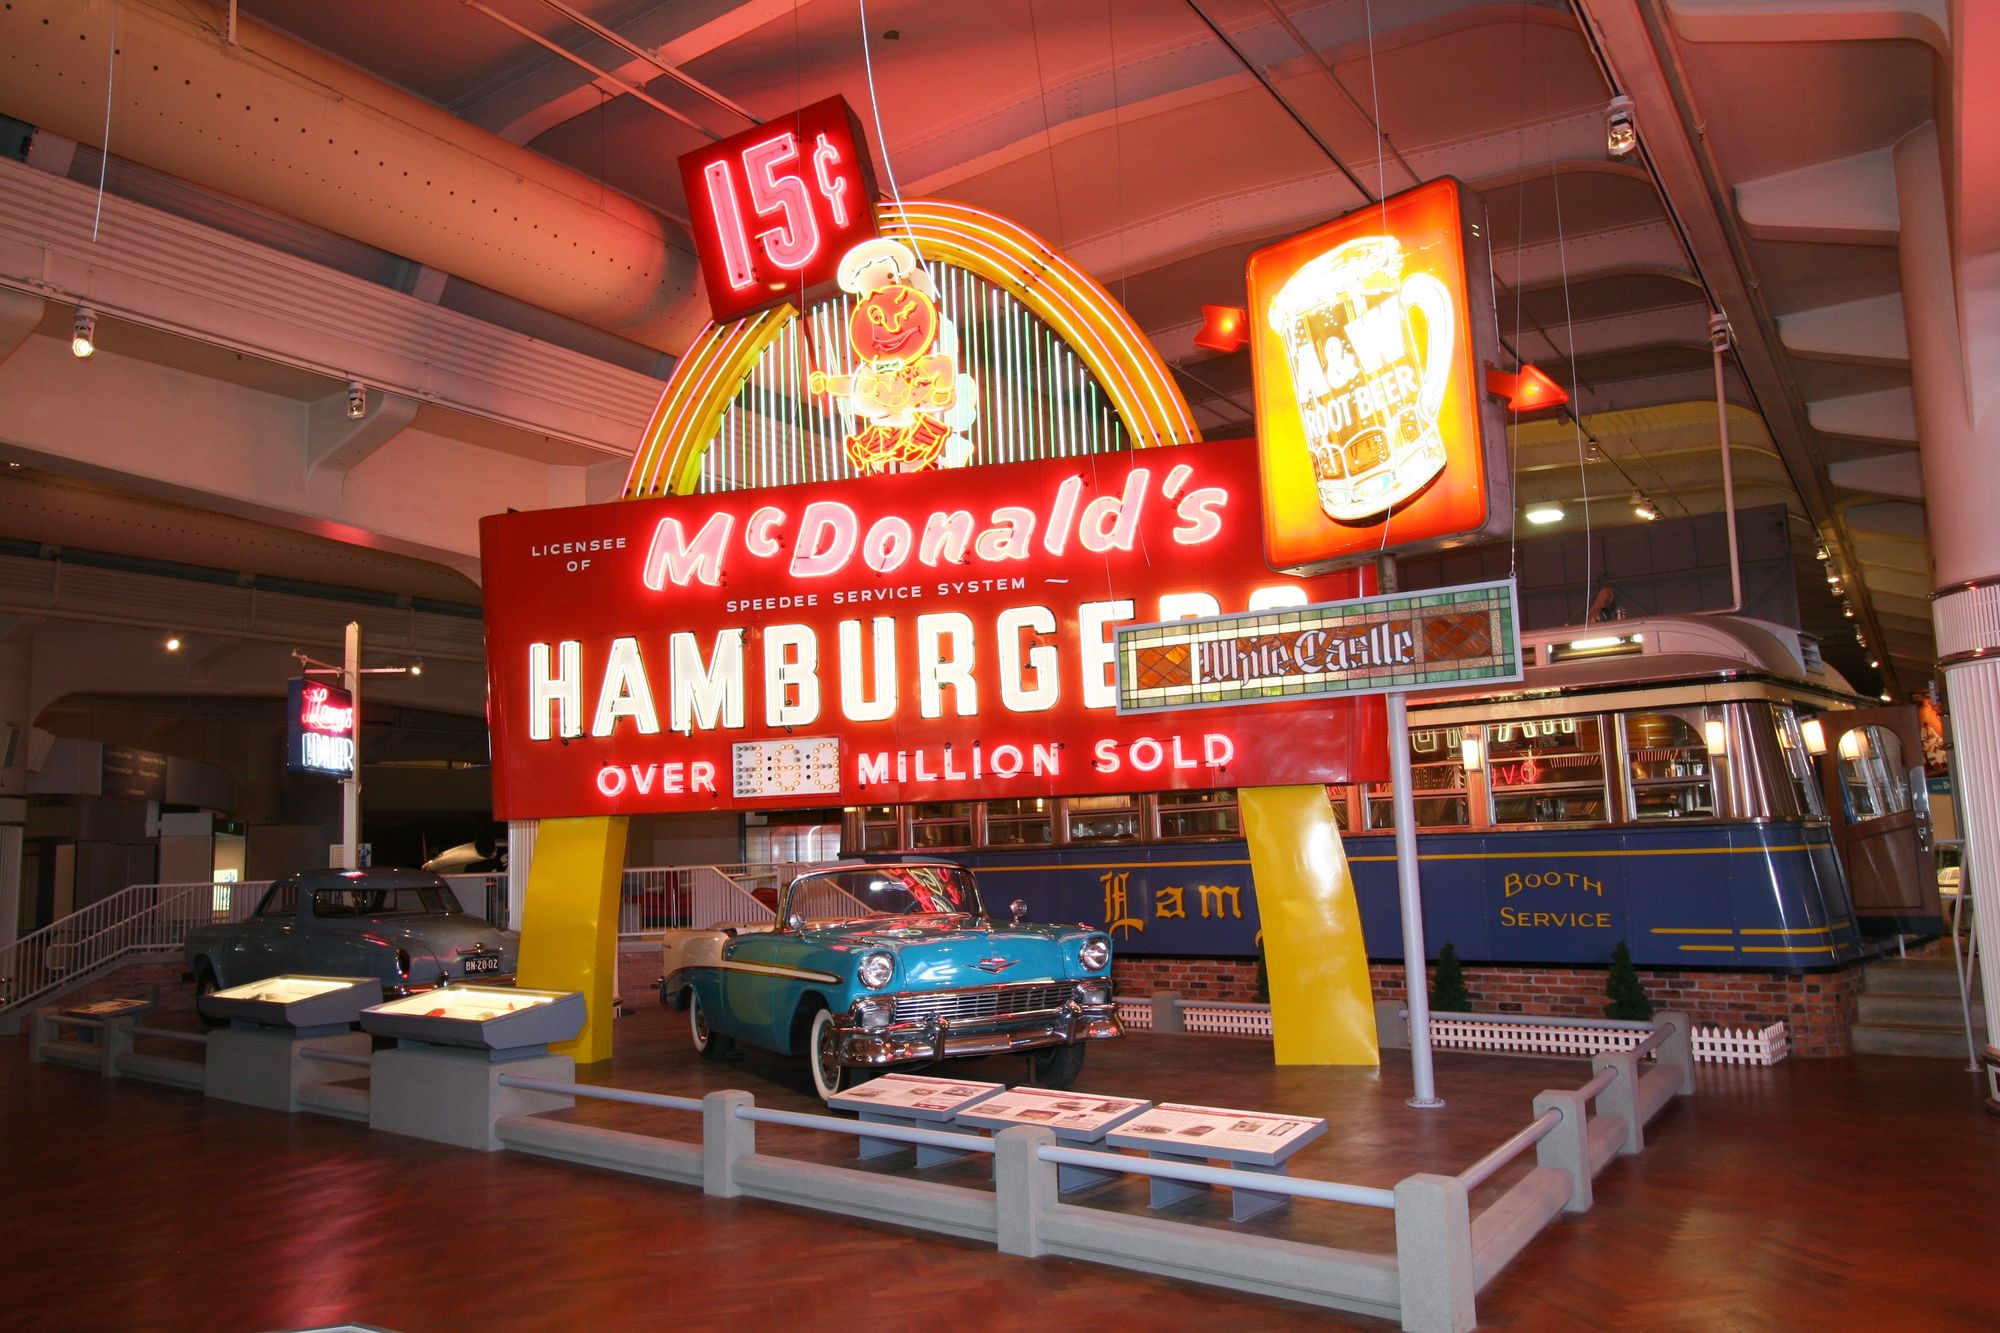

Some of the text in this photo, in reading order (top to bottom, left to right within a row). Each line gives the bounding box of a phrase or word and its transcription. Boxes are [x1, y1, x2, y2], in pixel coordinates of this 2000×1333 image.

[704, 131, 850, 291] 15¢
[1304, 364, 1420, 438] ROOT BEER
[531, 537, 626, 557] LICENSEE
[643, 463, 1229, 592] McDonald's
[566, 559, 591, 572] OF
[726, 577, 1026, 613] SPEEDEE SERVICE SYSTEM
[529, 586, 1309, 741] HAMBURGE
[1199, 622, 1415, 688] White Castle
[597, 761, 717, 798] OVER
[857, 743, 1062, 786] MILLION
[1093, 733, 1234, 774] SOLD
[1500, 906, 1612, 928] SERVICE
[1504, 871, 1602, 898] BOOTH
